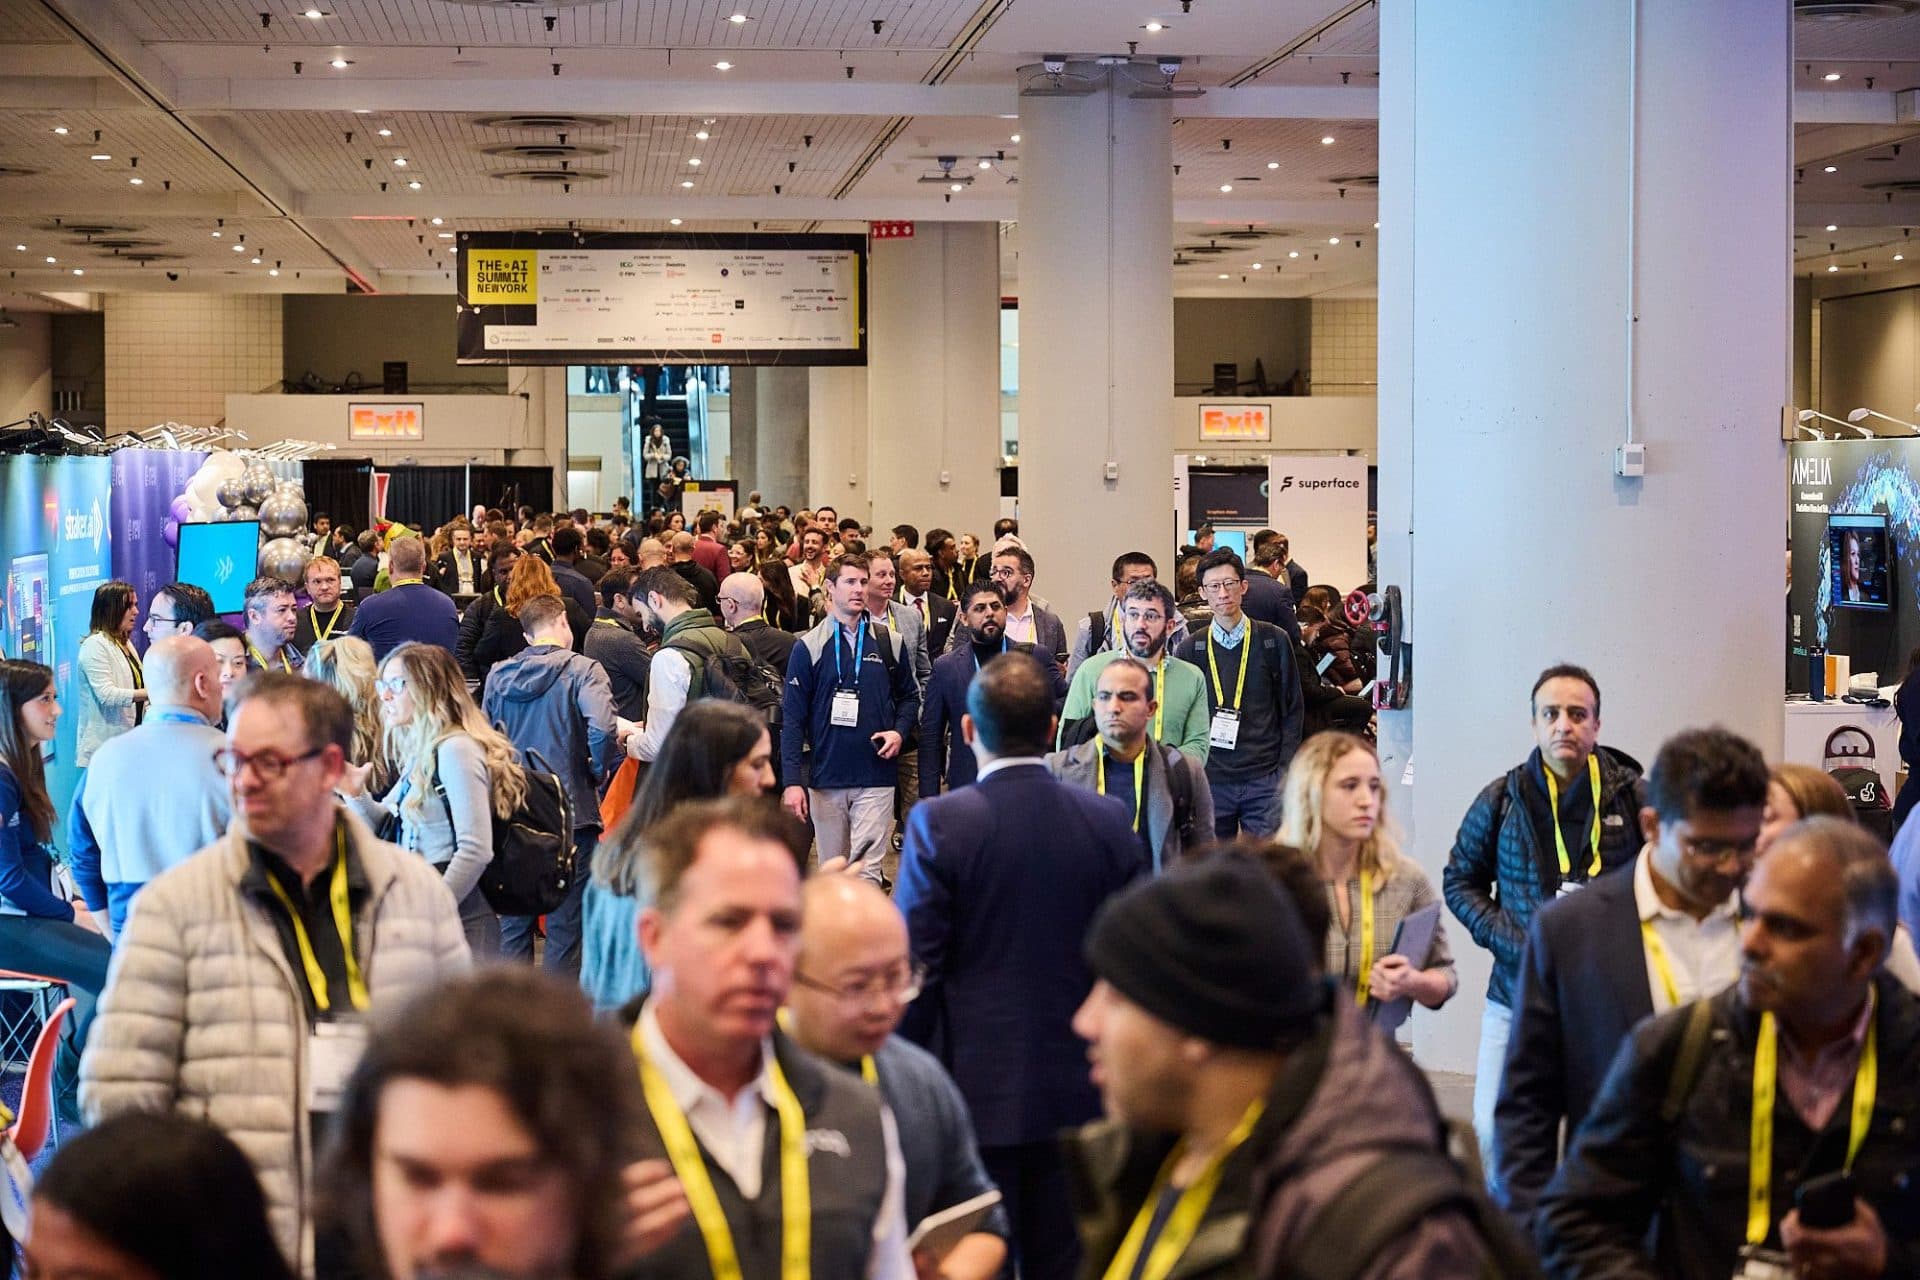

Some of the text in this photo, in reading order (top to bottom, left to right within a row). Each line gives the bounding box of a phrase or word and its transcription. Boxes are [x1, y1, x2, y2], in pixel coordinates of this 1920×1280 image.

[477, 260, 528, 271] THE AI
[477, 272, 528, 283] SUMMIT
[354, 409, 417, 435] Exit
[1204, 411, 1264, 435] Exit
[1792, 457, 1832, 485] AMELIA
[1298, 477, 1360, 490] superface
